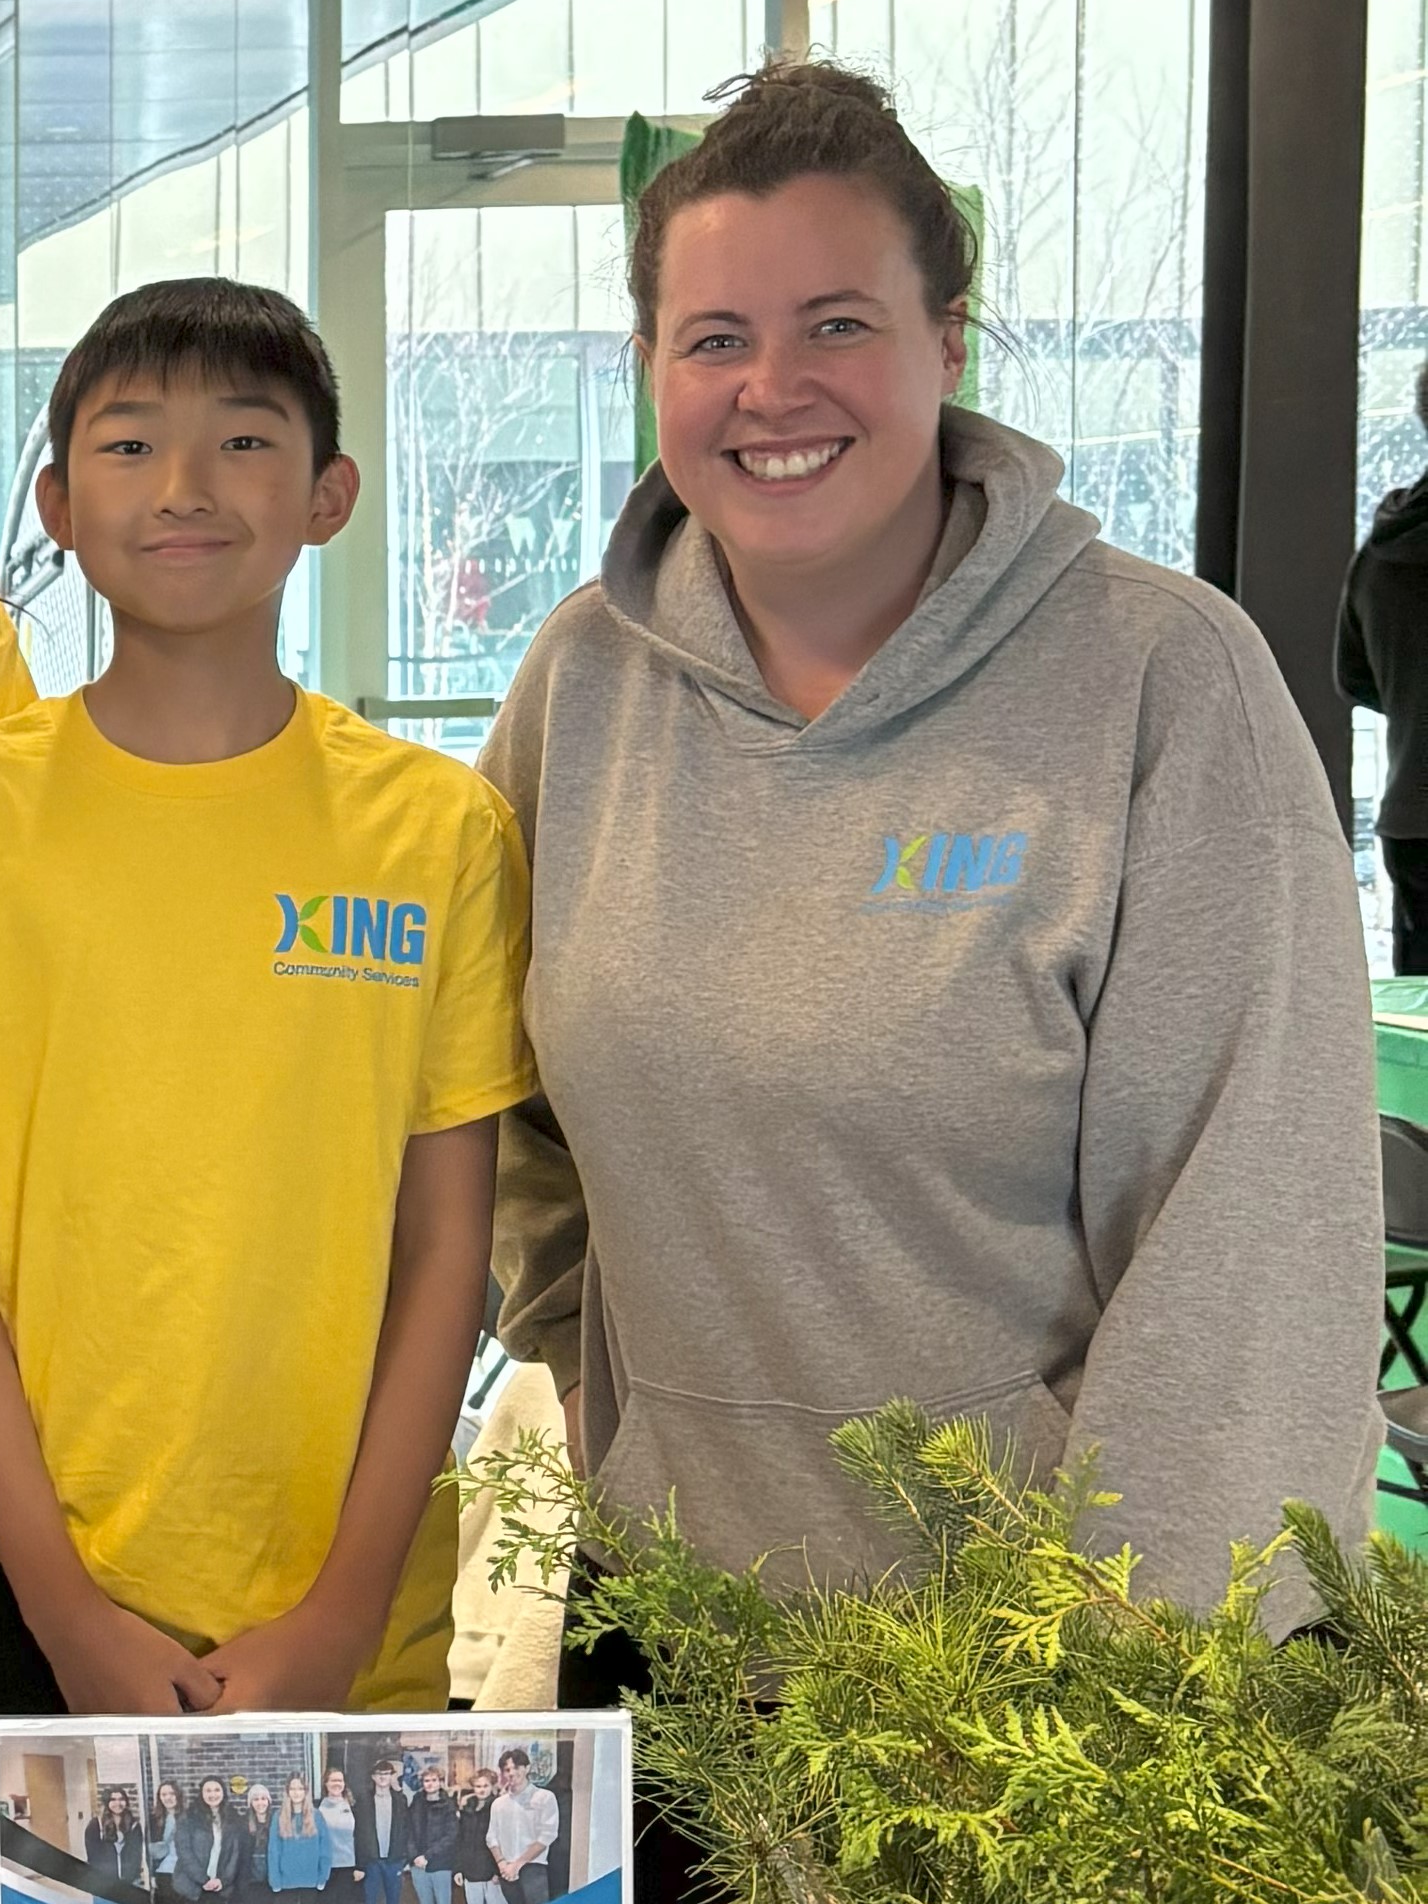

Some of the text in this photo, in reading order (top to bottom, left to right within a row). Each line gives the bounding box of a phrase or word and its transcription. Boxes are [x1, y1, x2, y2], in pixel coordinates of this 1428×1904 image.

[871, 832, 1027, 895] KING
[274, 893, 427, 965] KING
[273, 961, 420, 988] Community Services
